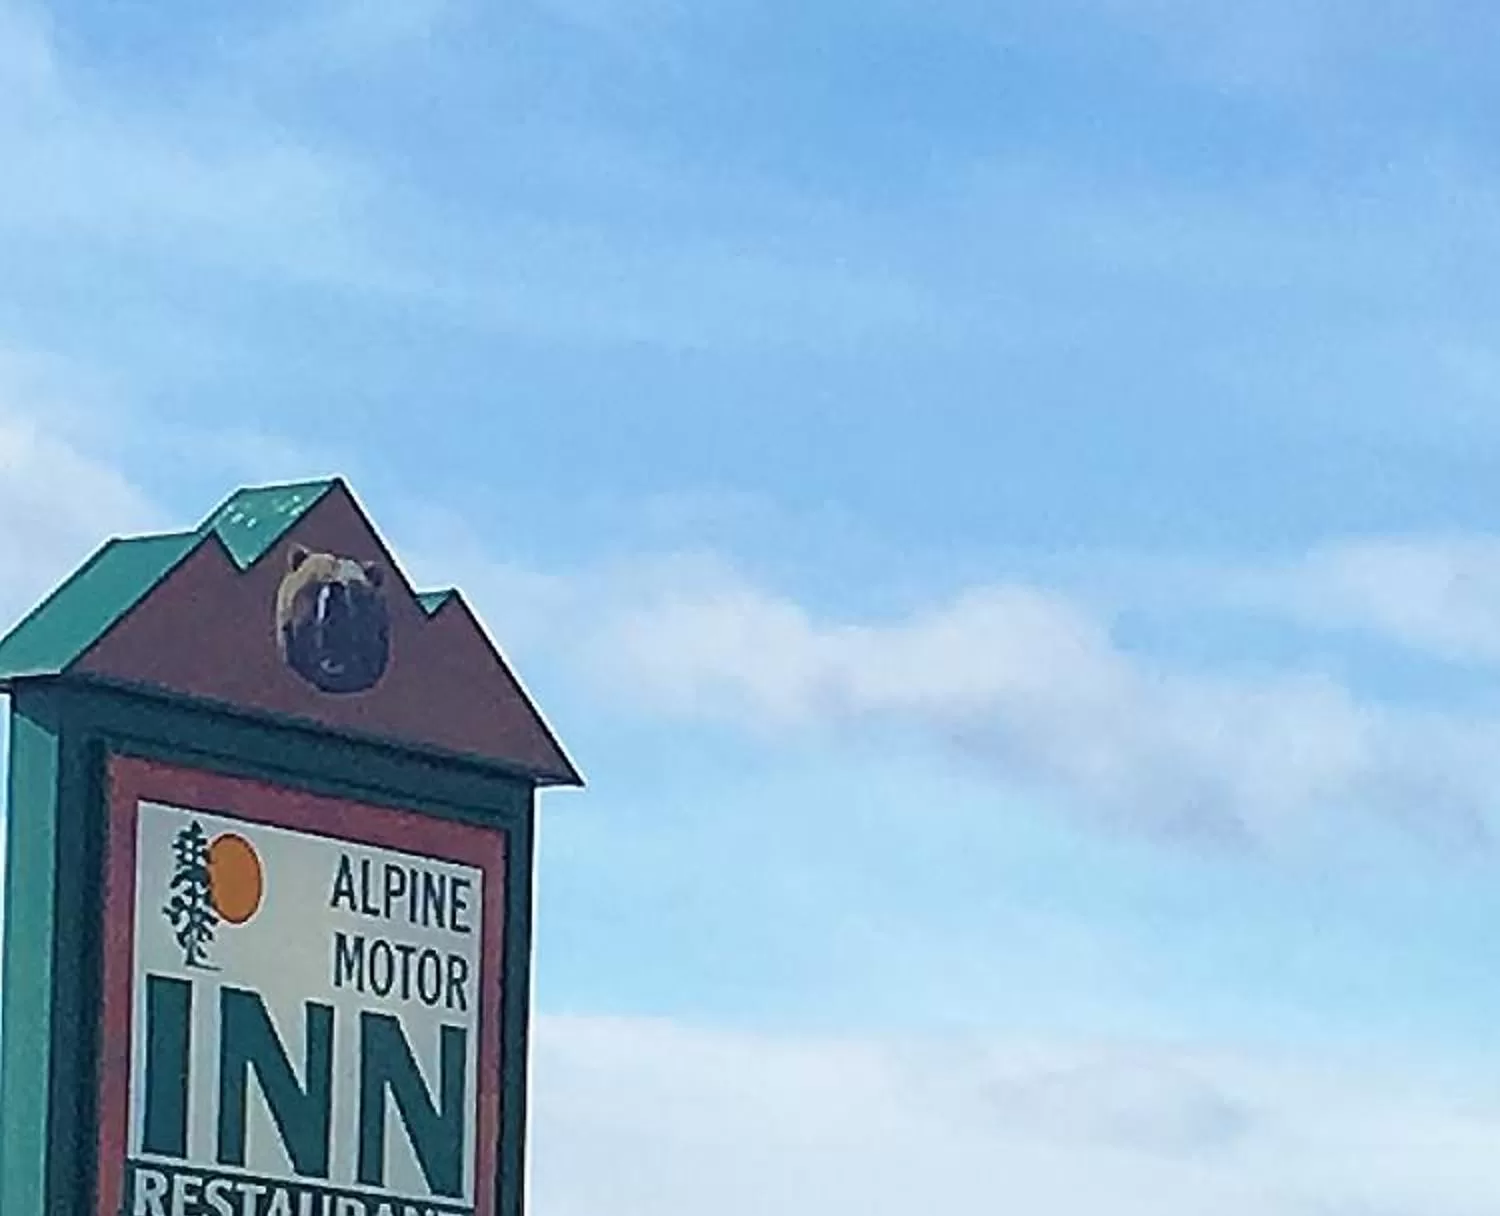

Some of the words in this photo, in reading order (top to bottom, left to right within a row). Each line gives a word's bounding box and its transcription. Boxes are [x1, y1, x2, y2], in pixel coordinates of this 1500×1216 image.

[329, 854, 473, 934] ALPINE
[333, 932, 468, 1012] MOTOR
[141, 973, 468, 1199] INN
